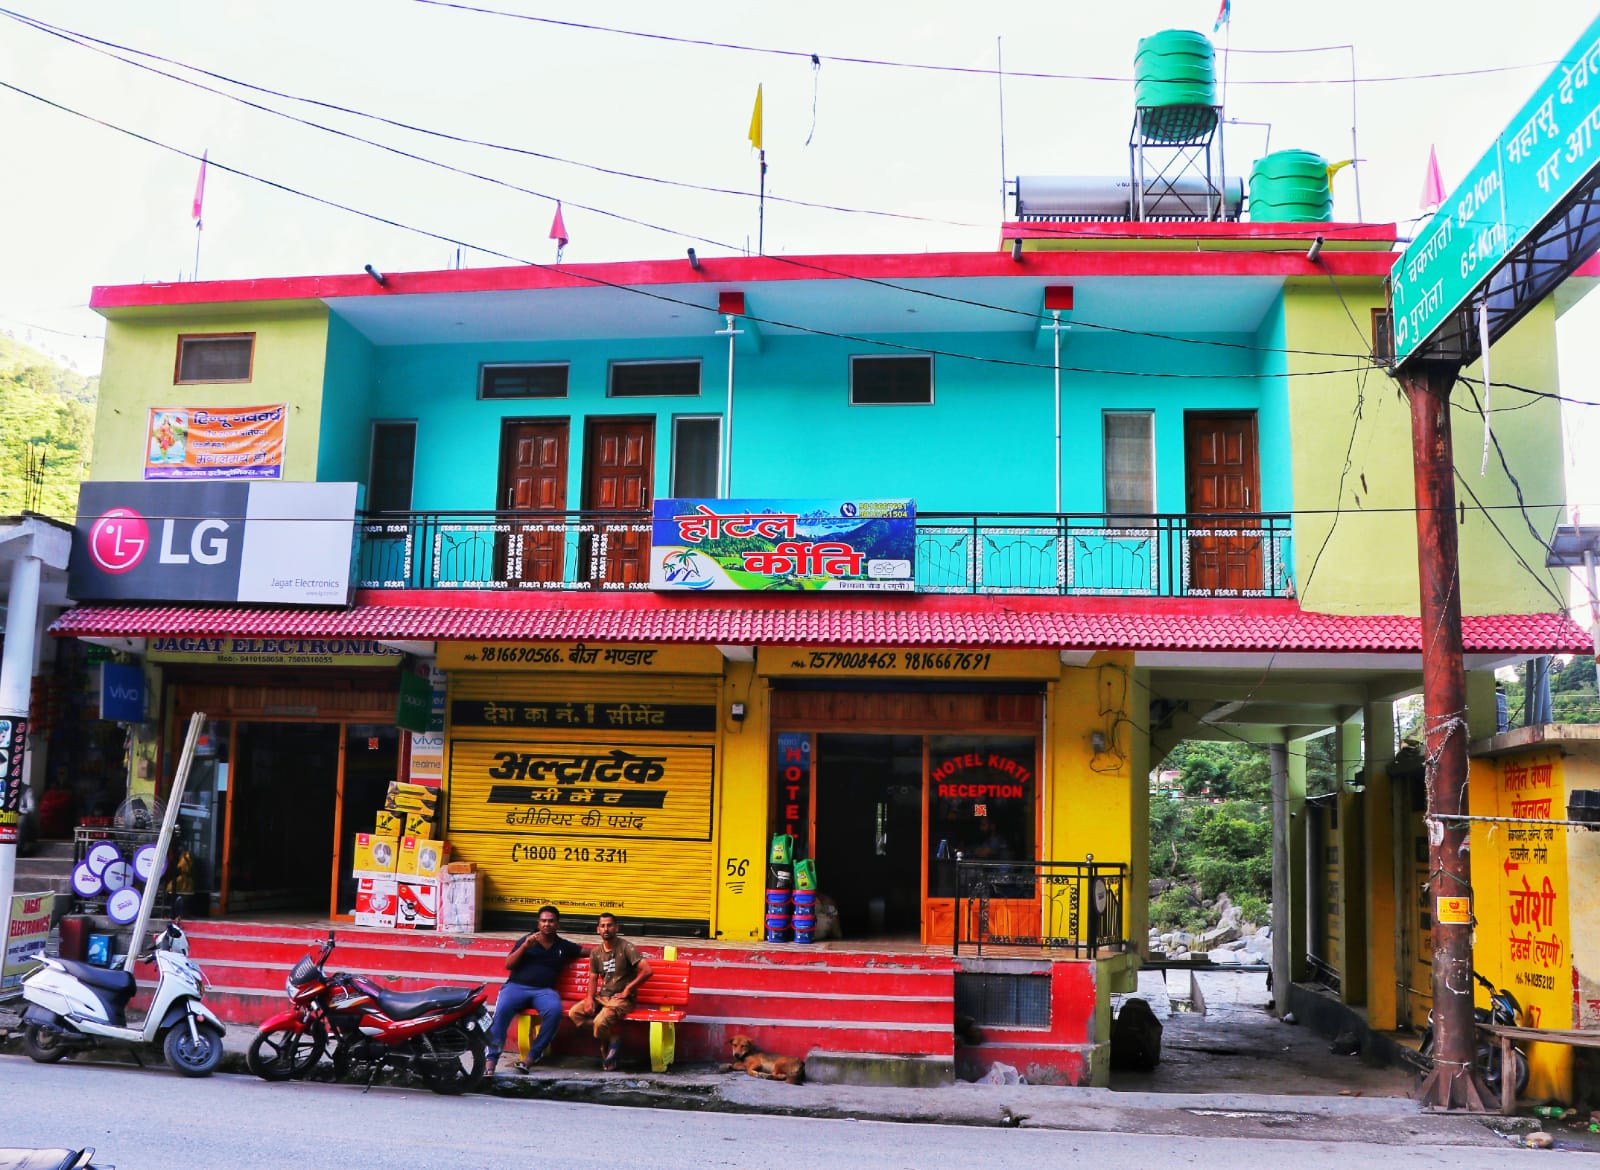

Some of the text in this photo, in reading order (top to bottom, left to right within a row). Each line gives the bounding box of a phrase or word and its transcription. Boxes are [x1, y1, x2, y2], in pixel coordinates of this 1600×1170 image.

[1506, 94, 1559, 164] महासू
[1536, 149, 1560, 193] पर
[1406, 214, 1453, 284] चकराता
[1410, 277, 1444, 344] पुरोला
[673, 505, 799, 542] होटल
[159, 518, 229, 566] LG
[271, 578, 340, 591] Jagat Electronics
[153, 637, 225, 653] JAGAT
[568, 642, 602, 664] बीज
[604, 649, 659, 665] भण्डार
[904, 653, 991, 670] 9816667691
[109, 682, 138, 701] vivo
[484, 702, 515, 724] देश
[524, 707, 548, 724] का
[606, 703, 665, 725] सीमेंट
[412, 736, 443, 746] vivo
[488, 749, 667, 785] अल्ट्राटेक
[931, 753, 1031, 784] HOTEL KIRTI
[785, 746, 802, 839] HOTEL
[938, 784, 1023, 799] RECEPTION
[1512, 793, 1552, 819] भोजनालय
[506, 807, 647, 831] इंजीनियर की पसंद
[523, 845, 628, 864] 1800 210 3311
[726, 858, 750, 877] 56
[23, 897, 42, 914] JAGAT
[1508, 874, 1556, 932] जोशी
[10, 914, 50, 937] ELECTRONICS
